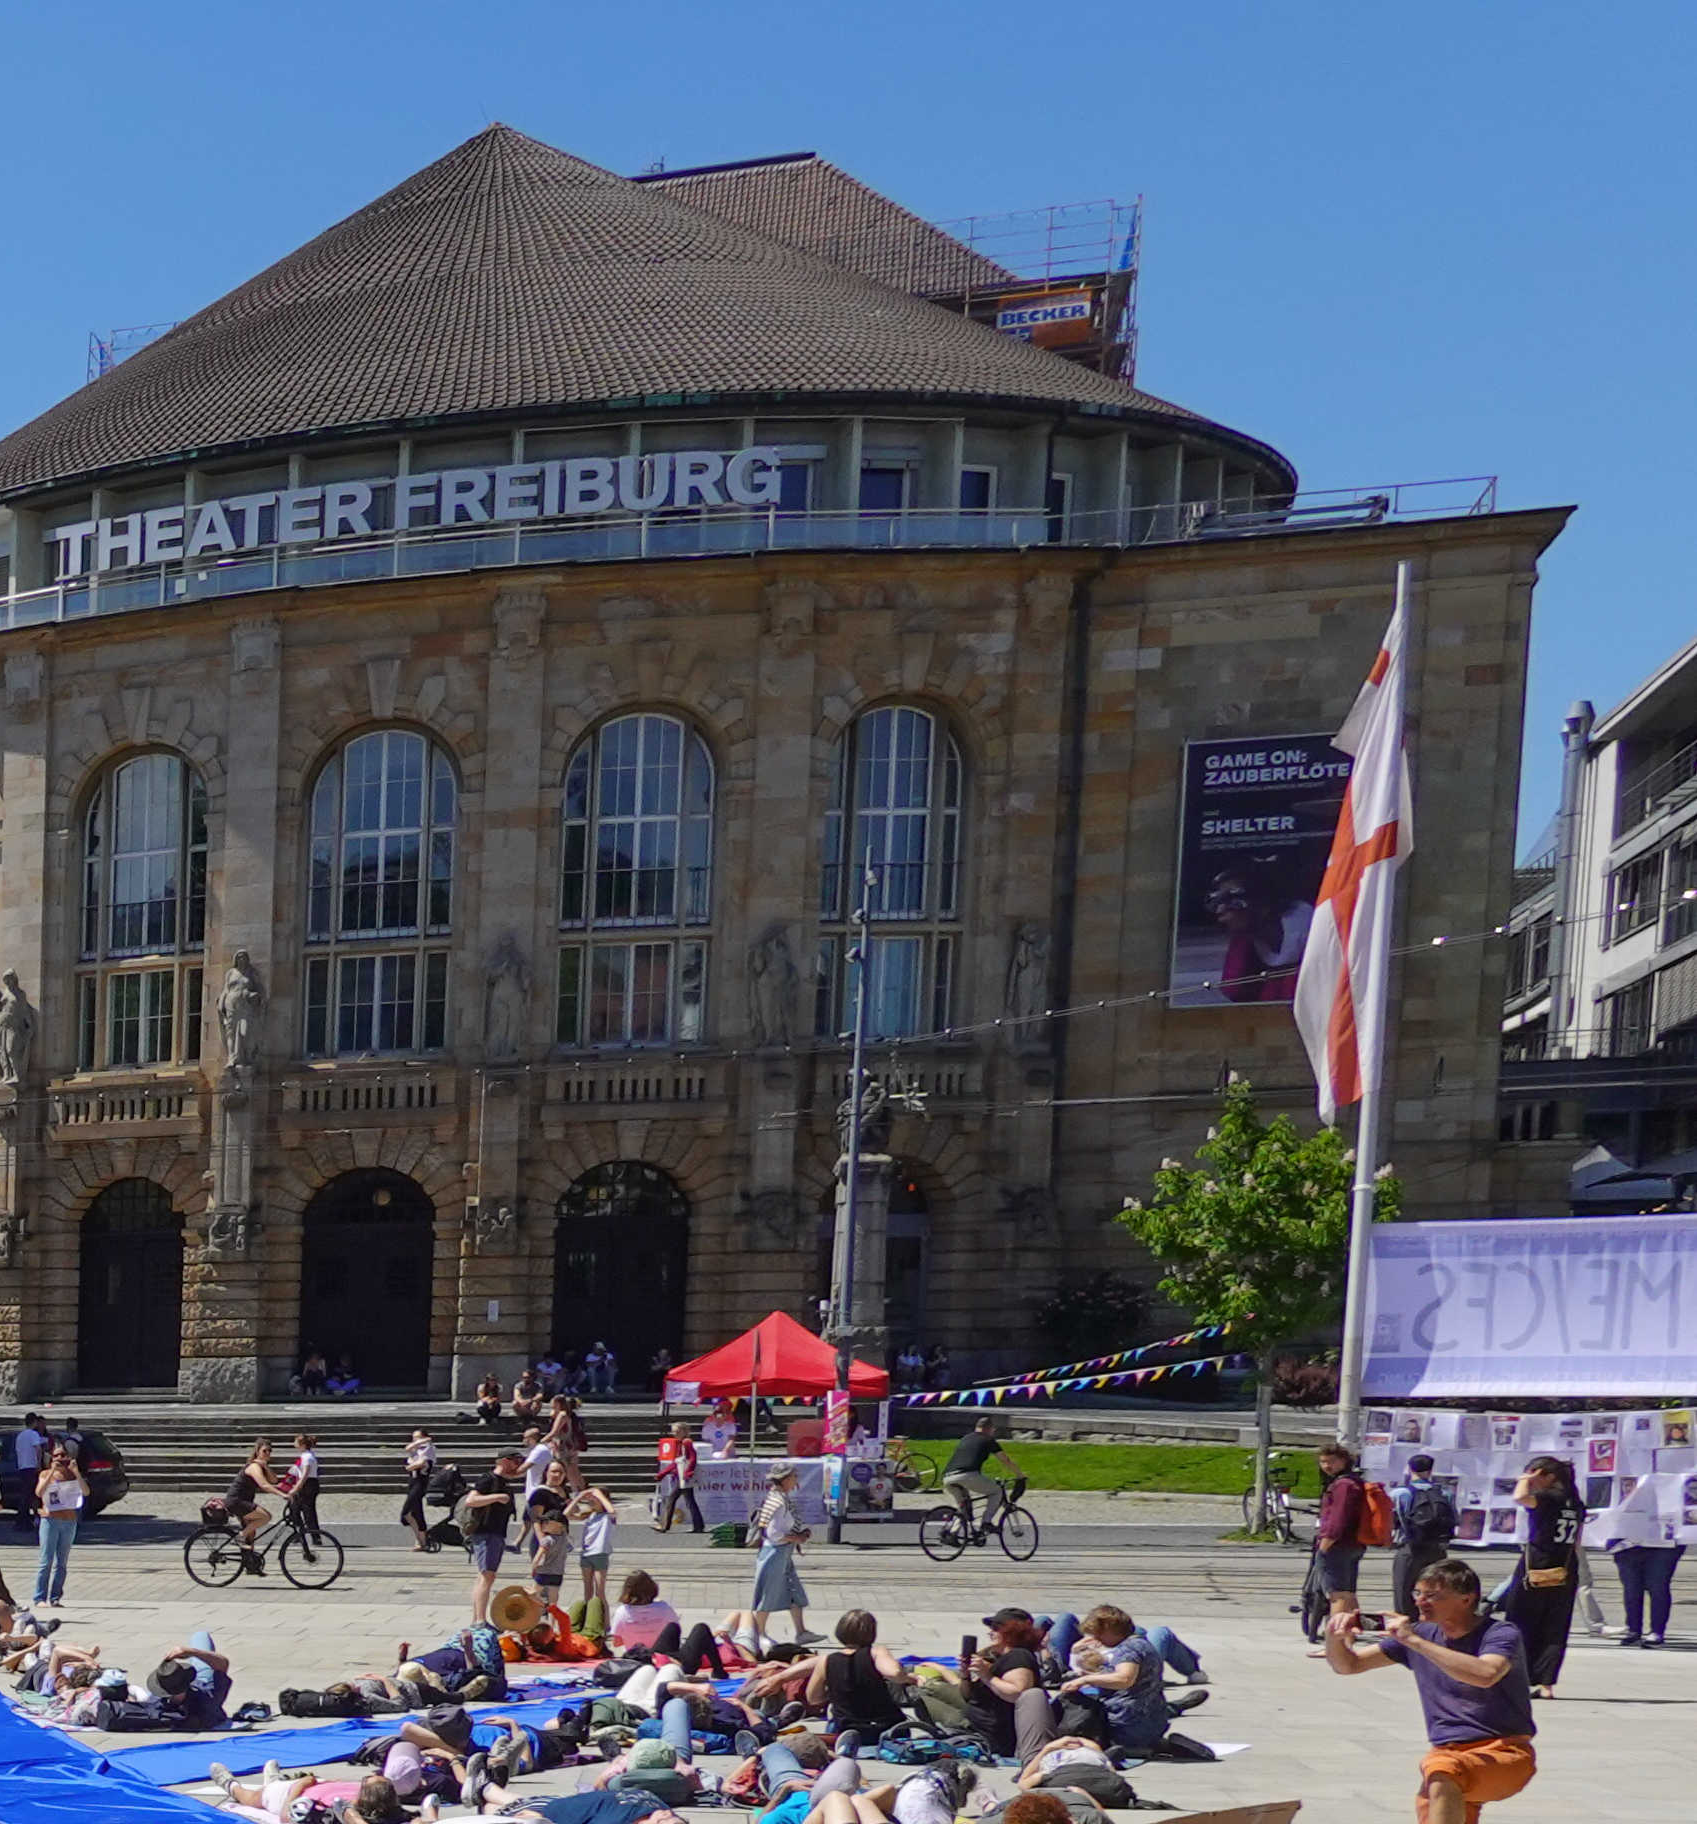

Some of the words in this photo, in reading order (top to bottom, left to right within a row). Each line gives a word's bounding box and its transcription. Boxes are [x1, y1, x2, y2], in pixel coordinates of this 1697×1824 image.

[1000, 304, 1086, 327] BECKER
[56, 480, 372, 580] THEATER
[394, 446, 784, 531] FREIBURG
[1205, 751, 1267, 769] GAME
[1270, 750, 1307, 765] ON:
[1203, 762, 1350, 786] ZAUBERFLÖTE
[1201, 816, 1295, 835] SHELTER
[1554, 1519, 1578, 1544] 32
